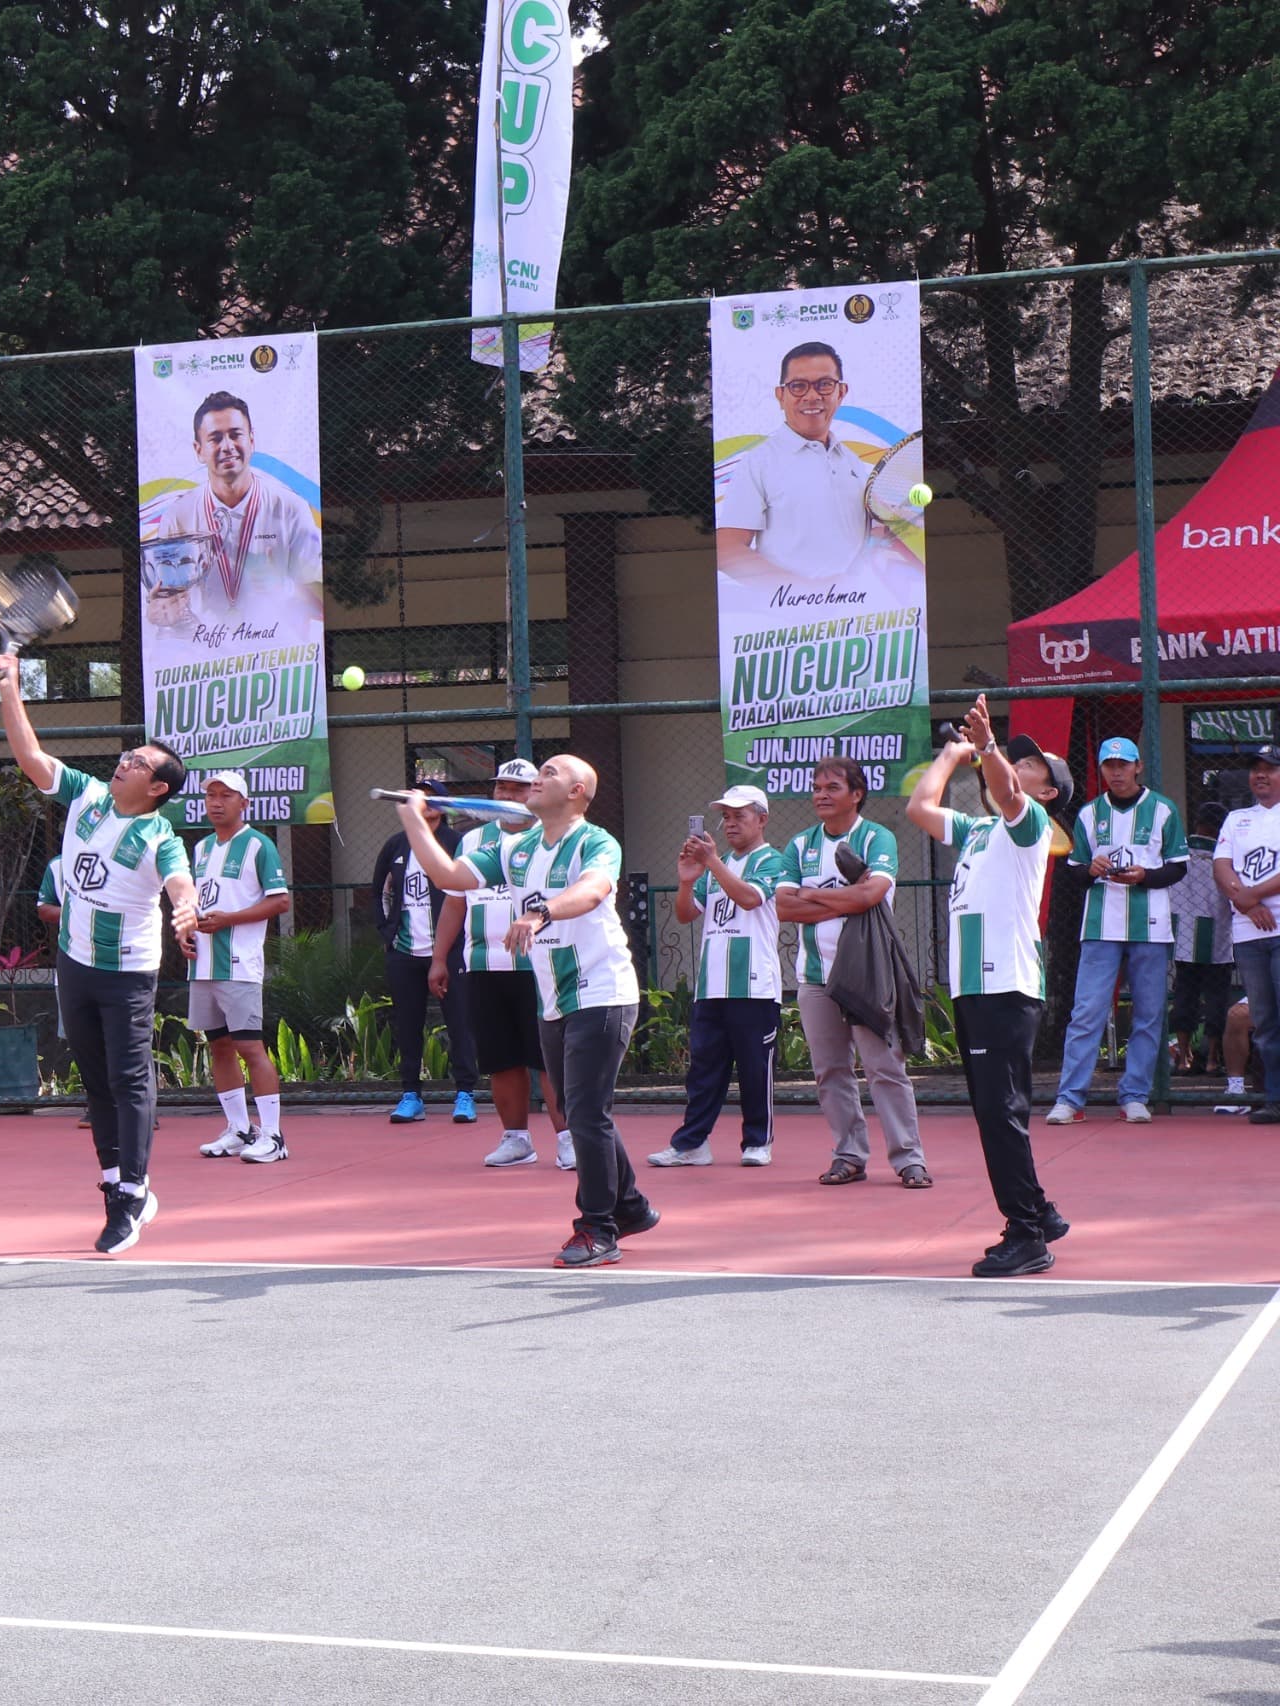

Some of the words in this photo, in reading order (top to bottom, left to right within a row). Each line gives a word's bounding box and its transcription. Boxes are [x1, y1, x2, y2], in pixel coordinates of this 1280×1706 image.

[507, 259, 540, 281] CNU
[800, 304, 837, 315] PCNU
[211, 354, 244, 364] PCNU
[1182, 516, 1280, 549] bank
[770, 584, 867, 608] Nurochman
[193, 623, 229, 648] Raffi
[232, 621, 279, 641] Ahmad
[733, 618, 850, 654] TOURNAMENT
[855, 608, 918, 633] TENNIS
[1130, 632, 1208, 663] BANK
[1216, 626, 1280, 656] JATI
[155, 654, 255, 688] TOURNAMENT
[259, 643, 316, 668] TENNIS
[732, 650, 782, 706] NU
[791, 638, 866, 695] CUP
[875, 628, 914, 684] III
[154, 684, 194, 738] NU
[206, 672, 269, 728] CUP
[279, 665, 313, 716] III
[732, 704, 775, 727] PIALA
[781, 691, 861, 720] WALIKOTA
[867, 683, 911, 708] BATU
[198, 721, 266, 751] WALIKOTA
[274, 717, 311, 740] BATU
[747, 736, 835, 764] JUNJUNG
[839, 735, 902, 761] TINGGI
[249, 766, 305, 792] TINGGI
